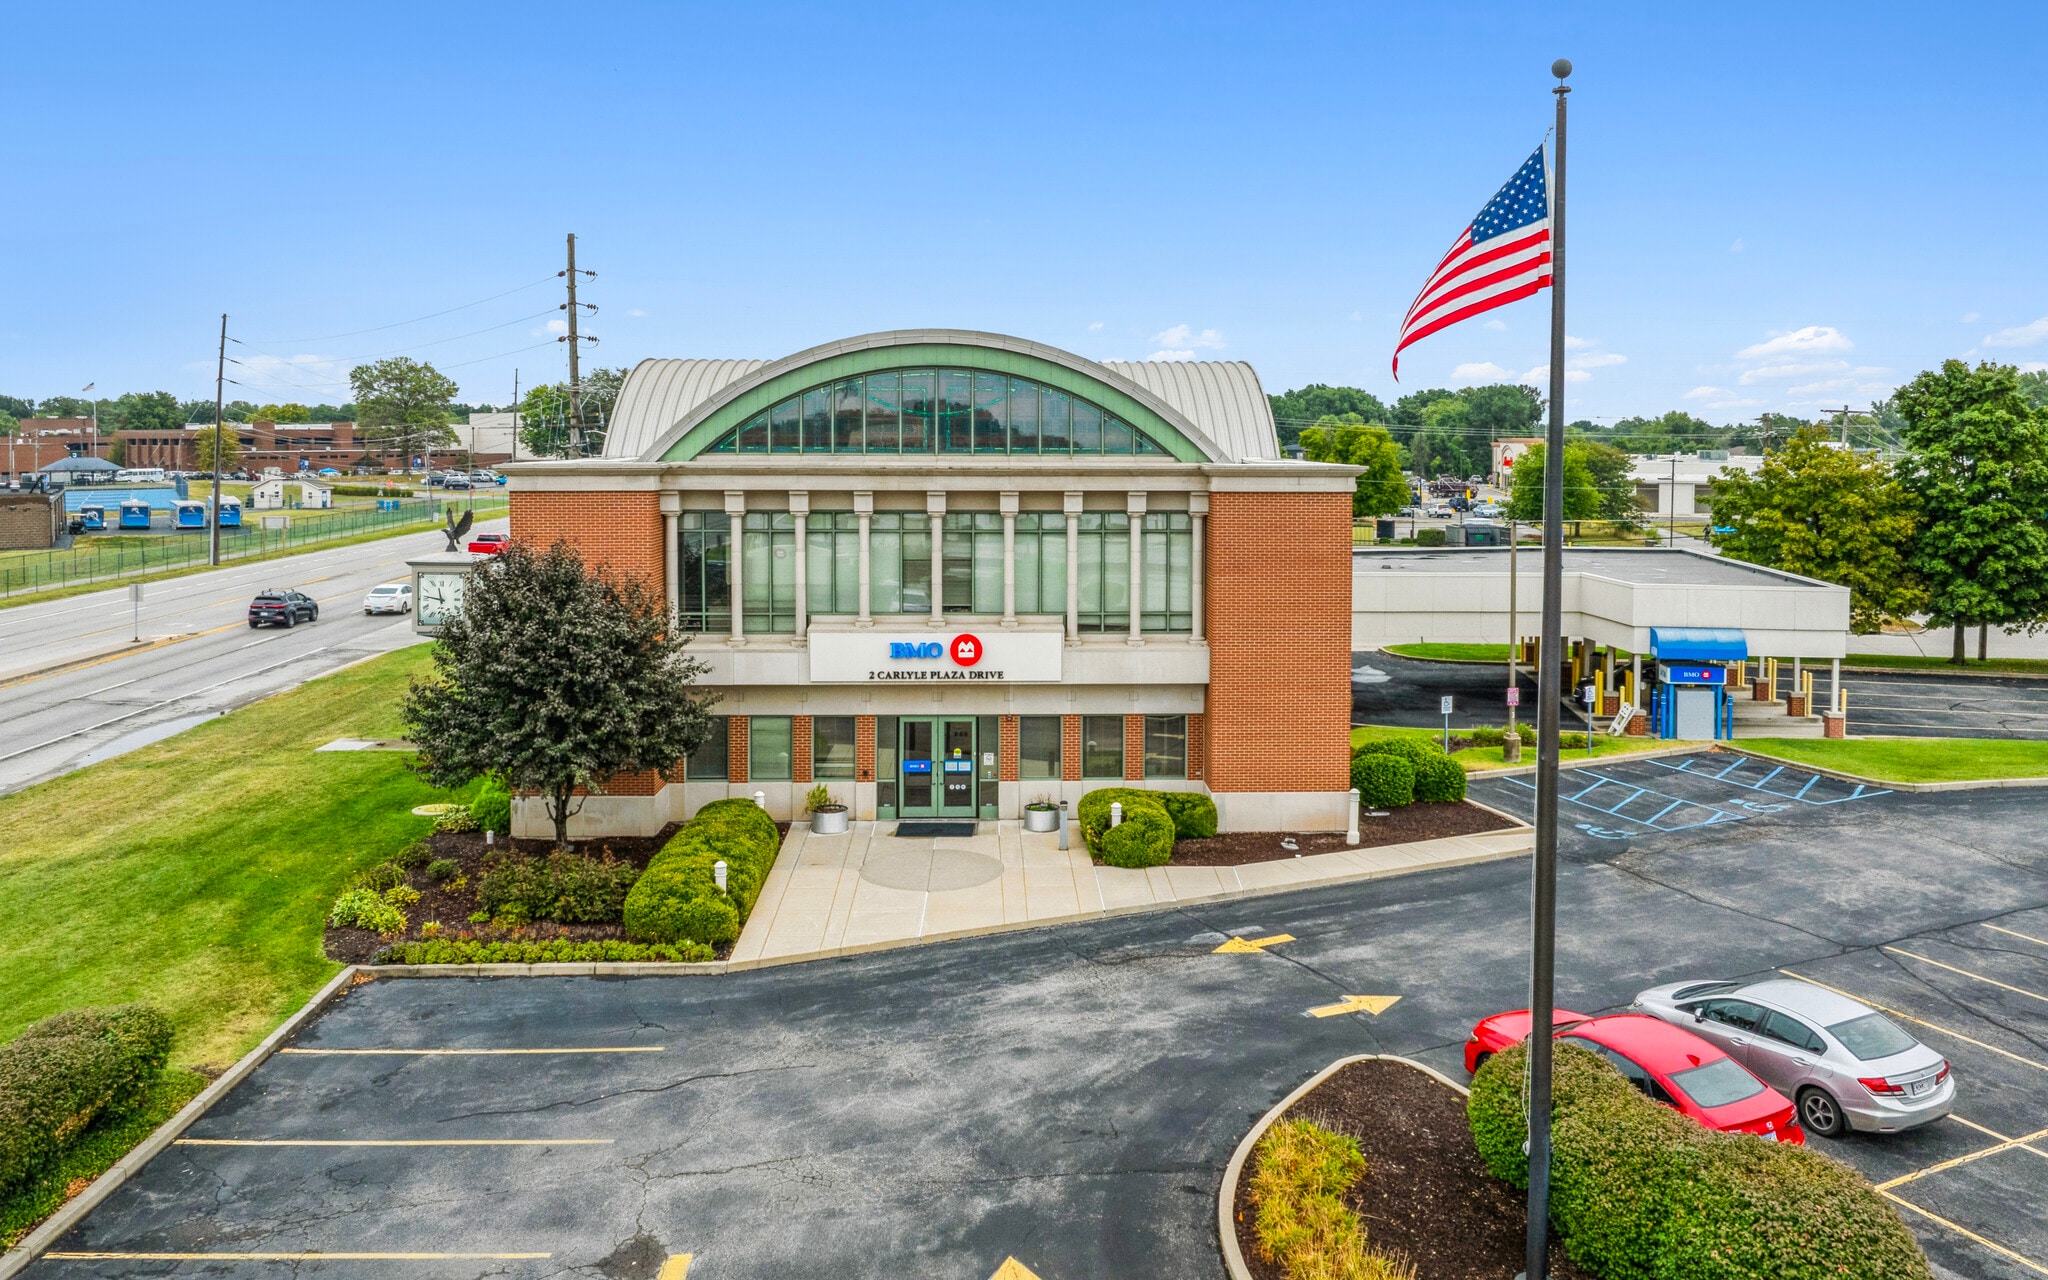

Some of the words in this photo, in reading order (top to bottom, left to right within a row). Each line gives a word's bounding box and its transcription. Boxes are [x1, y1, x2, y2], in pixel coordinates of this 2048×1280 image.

[889, 642, 944, 659] BMO
[869, 671, 875, 680] 2
[877, 671, 927, 680] CARLYLE
[930, 671, 966, 680] PLAZA
[969, 671, 1004, 680] DRIVE
